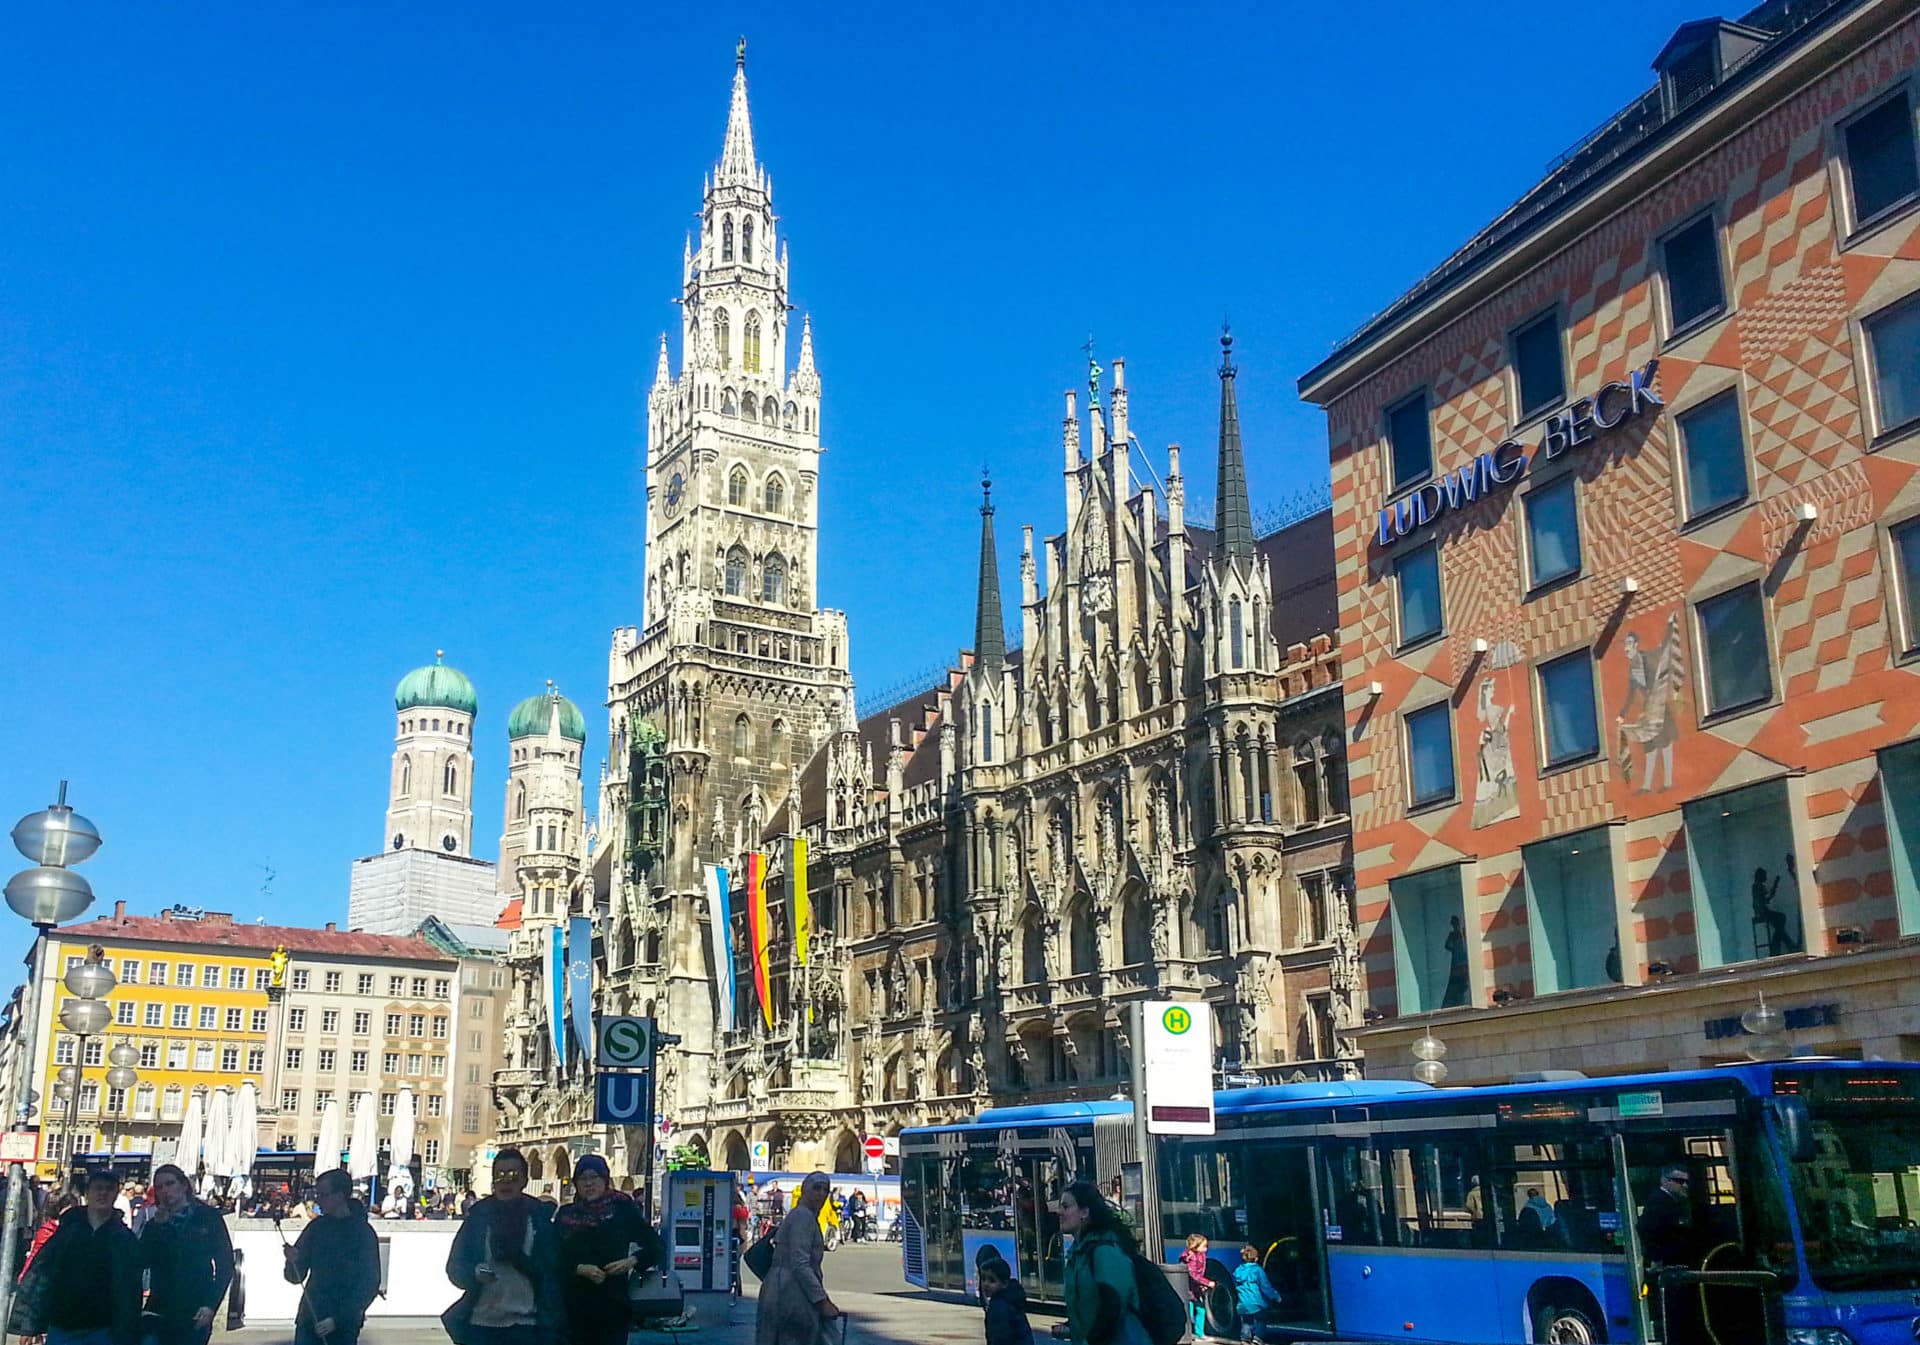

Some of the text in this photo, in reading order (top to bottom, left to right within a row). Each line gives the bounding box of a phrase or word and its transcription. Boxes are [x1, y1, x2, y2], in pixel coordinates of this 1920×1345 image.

[1378, 359, 1665, 546] LUDWIG BECK
[610, 1022, 640, 1060] S
[1169, 1013, 1185, 1029] H
[607, 1077, 640, 1119] U
